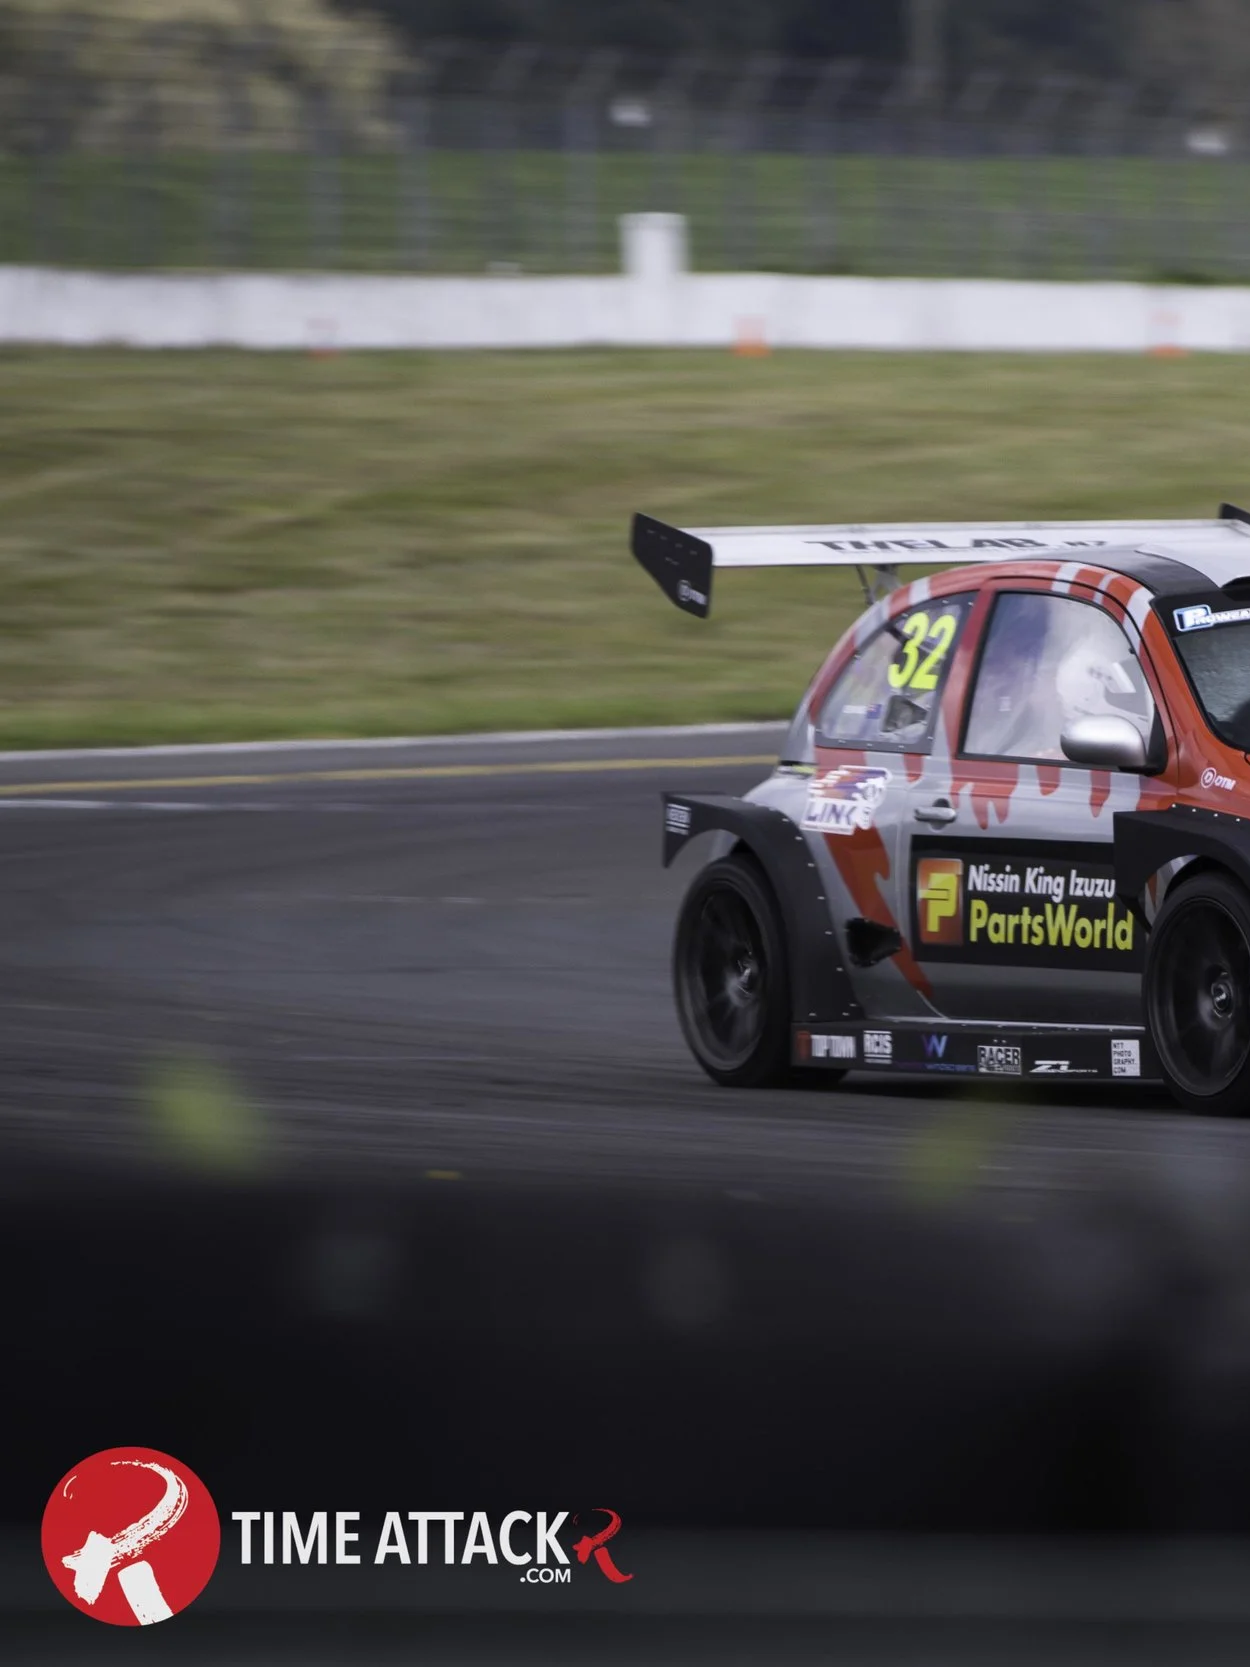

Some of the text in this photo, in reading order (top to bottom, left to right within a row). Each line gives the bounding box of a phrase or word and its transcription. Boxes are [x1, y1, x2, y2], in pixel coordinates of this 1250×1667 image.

[888, 611, 957, 689] 32
[804, 802, 857, 826] LINK
[967, 864, 1116, 903] Nissin King Izuzu
[969, 899, 1134, 950] PartsWorld
[978, 1047, 1020, 1065] RACER
